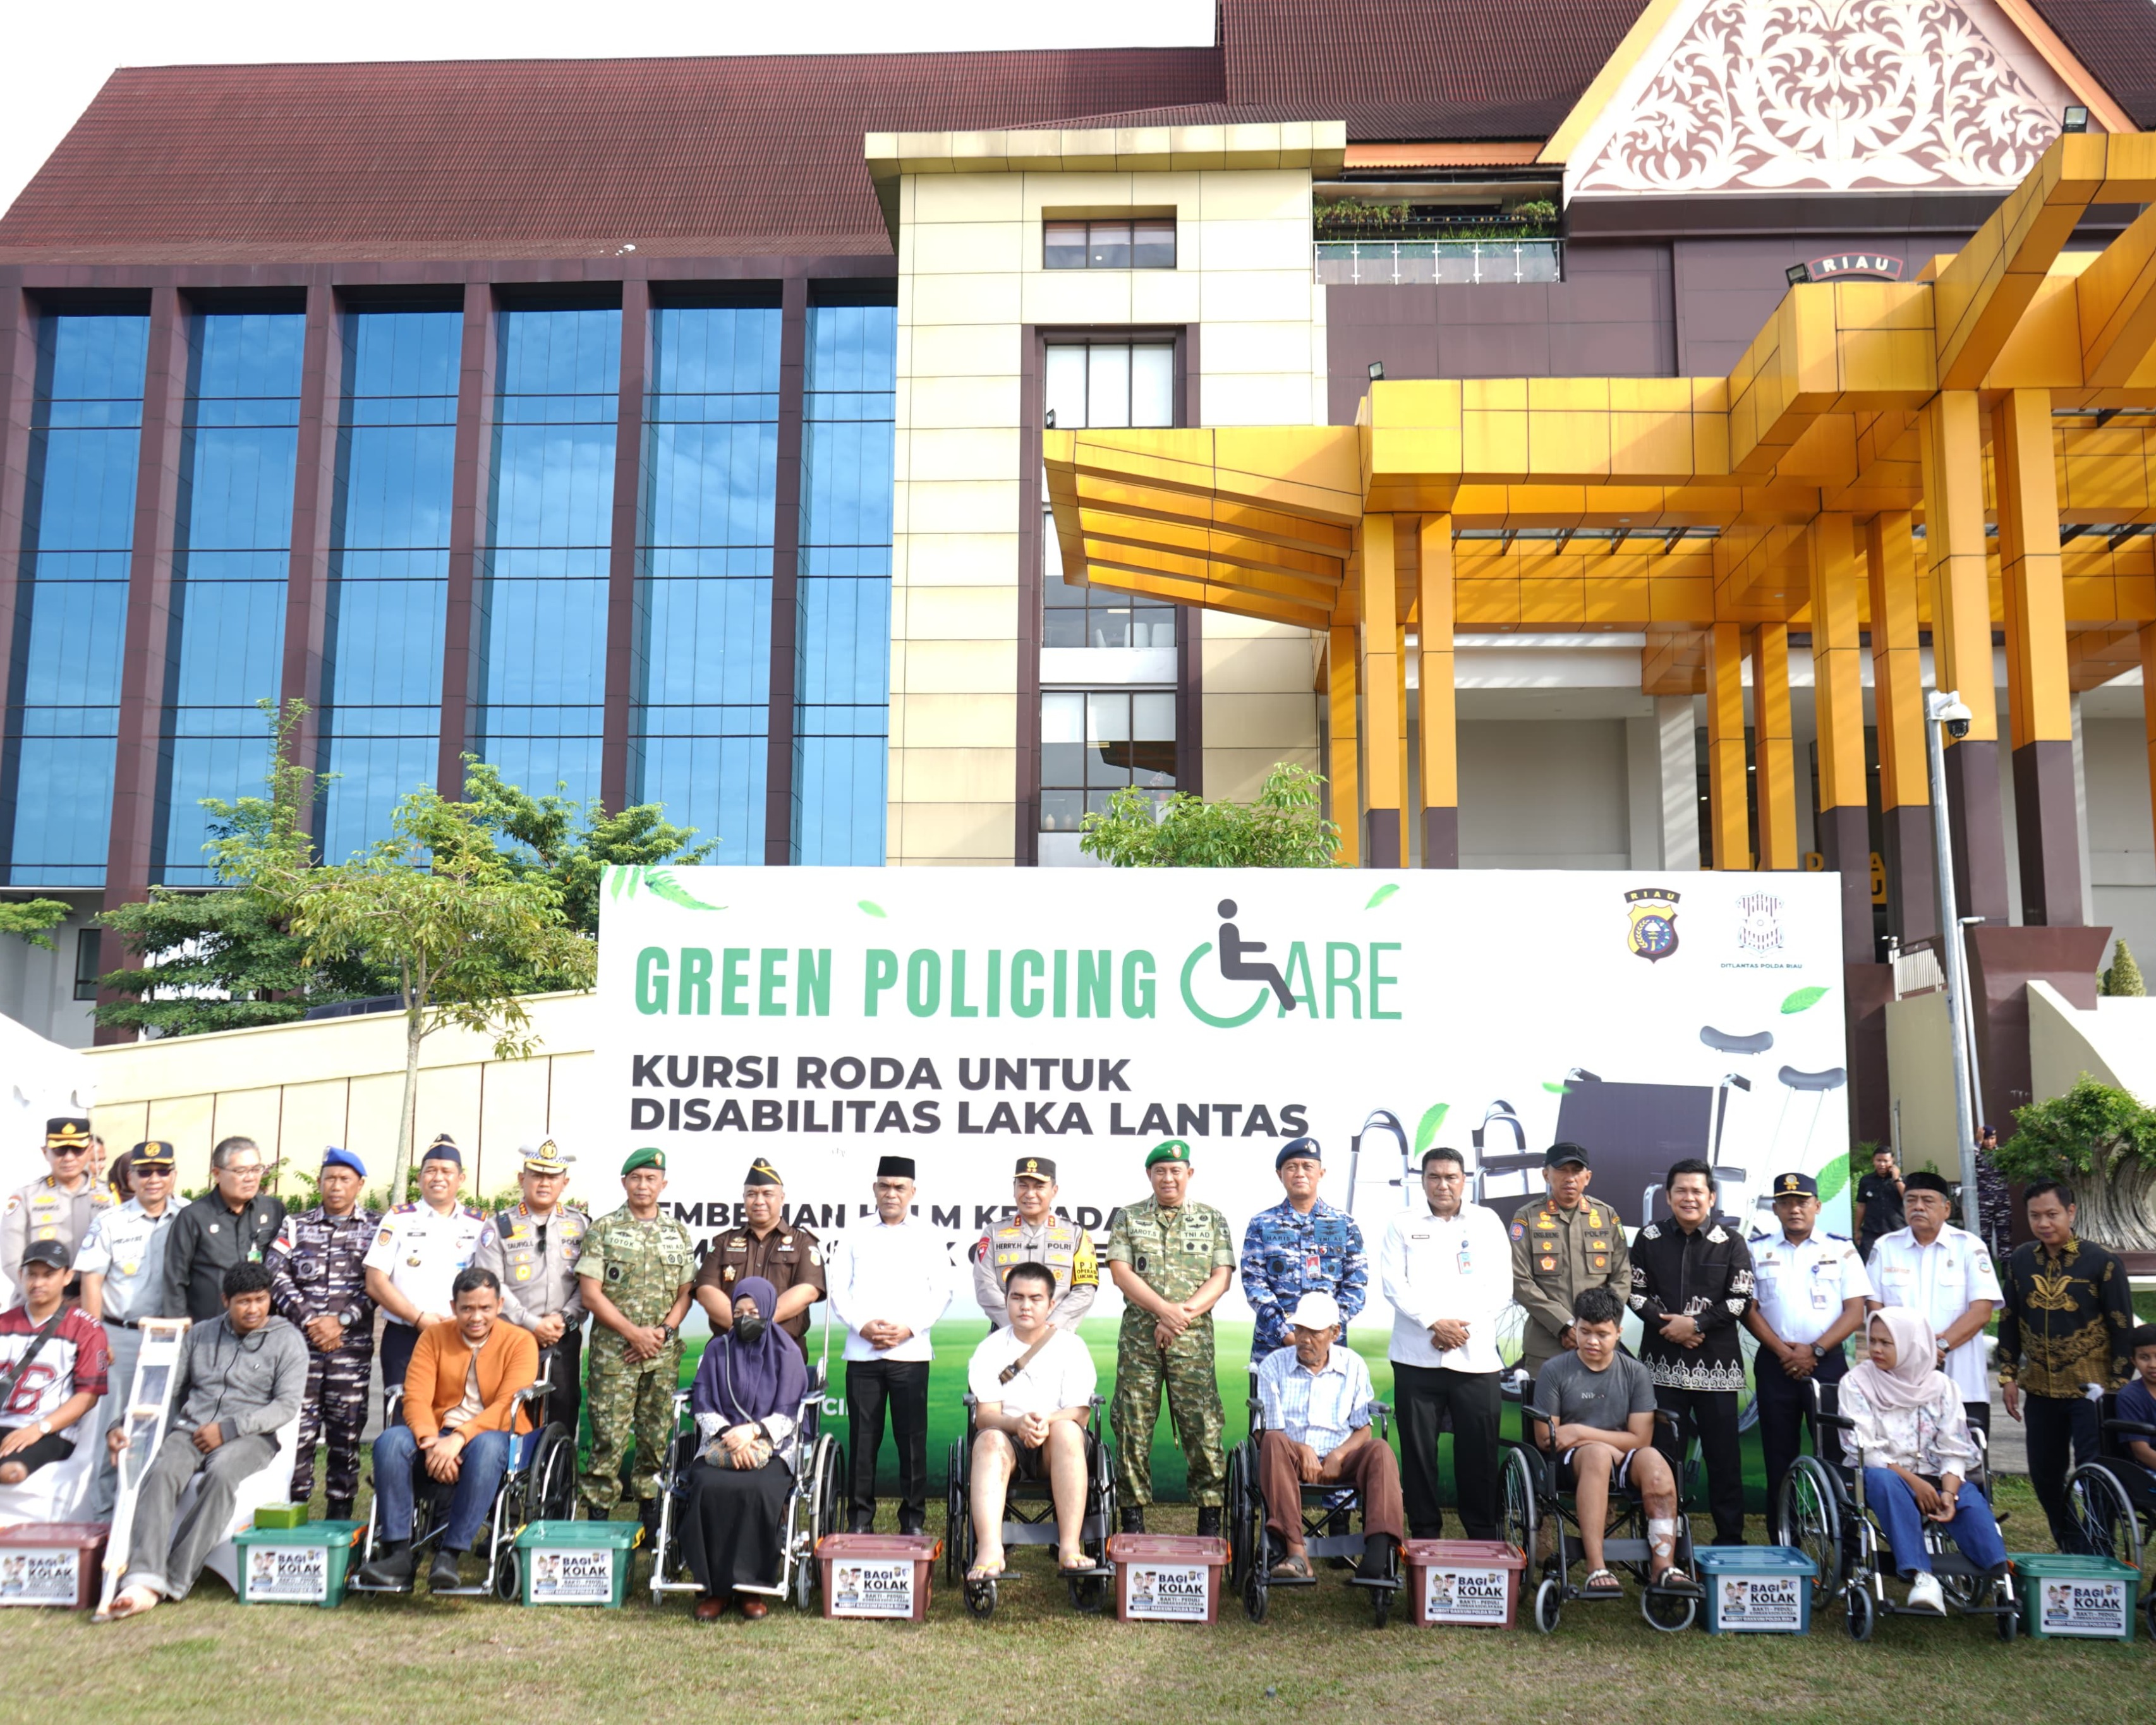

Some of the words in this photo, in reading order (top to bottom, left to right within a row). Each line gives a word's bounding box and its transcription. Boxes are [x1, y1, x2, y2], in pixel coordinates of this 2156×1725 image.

[1822, 255, 1889, 272] RIAU
[1630, 891, 1675, 900] RIAU
[635, 947, 832, 1017] GREEN
[864, 948, 1156, 1019] POLICING
[632, 1055, 778, 1089] KURSI
[796, 1056, 943, 1090] RODA
[958, 1058, 1132, 1092] UNTUK
[631, 1098, 942, 1134] DISABILITAS
[958, 1101, 1094, 1135] LAKA
[1110, 1103, 1309, 1138] LANTAS
[610, 1238, 634, 1247] TOTOK
[28, 1558, 57, 1567] BAGI
[28, 1568, 73, 1579] KOLAK
[279, 1565, 321, 1573] KOLAK
[563, 1567, 607, 1576] KOLAK
[864, 1571, 892, 1579] BAGI
[1159, 1575, 1187, 1583] BAGI
[864, 1580, 908, 1590] KOLAK
[1458, 1577, 1487, 1585] BAGI
[1159, 1584, 1202, 1594] KOLAK
[1458, 1587, 1502, 1596] KOLAK
[2075, 1589, 2104, 1597] BAGI
[1751, 1594, 1795, 1602] KOLAK
[2075, 1598, 2120, 1608] KOLAK
